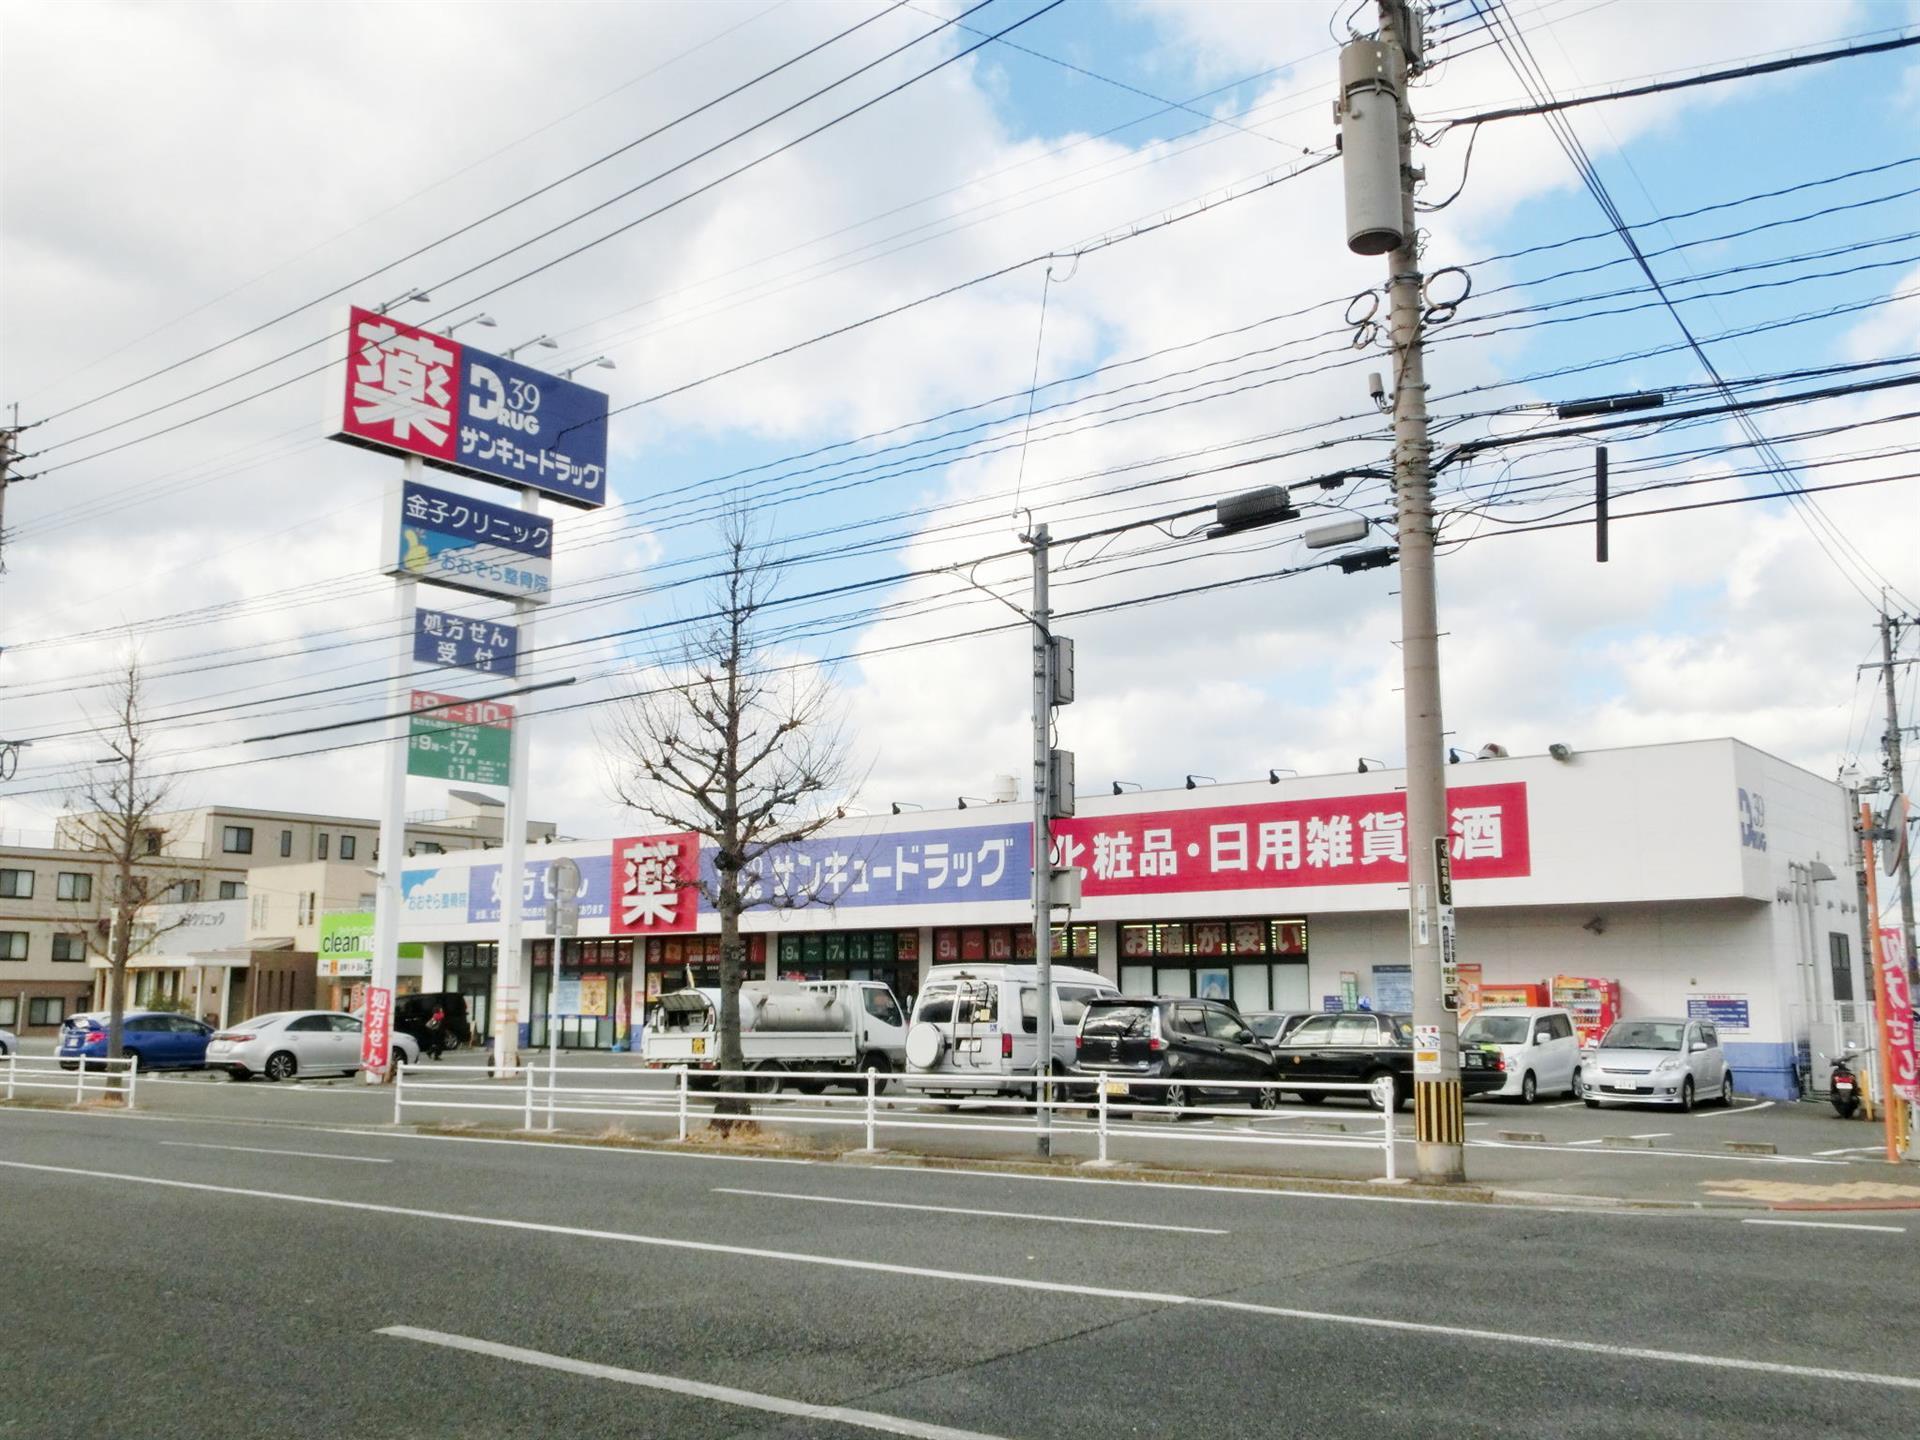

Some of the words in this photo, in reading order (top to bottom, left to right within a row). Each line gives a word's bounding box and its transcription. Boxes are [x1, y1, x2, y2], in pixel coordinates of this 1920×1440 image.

[353, 322, 454, 447] 薬
[507, 377, 541, 414] 39
[460, 425, 604, 489] サンキュードラッグ
[406, 494, 549, 549] 金子クリニック
[423, 613, 509, 648] 処方せん
[621, 840, 680, 926] 薬
[771, 838, 1015, 896] サンキュードラッグ
[322, 932, 360, 953] clean
[368, 990, 388, 1066] 処方せん
